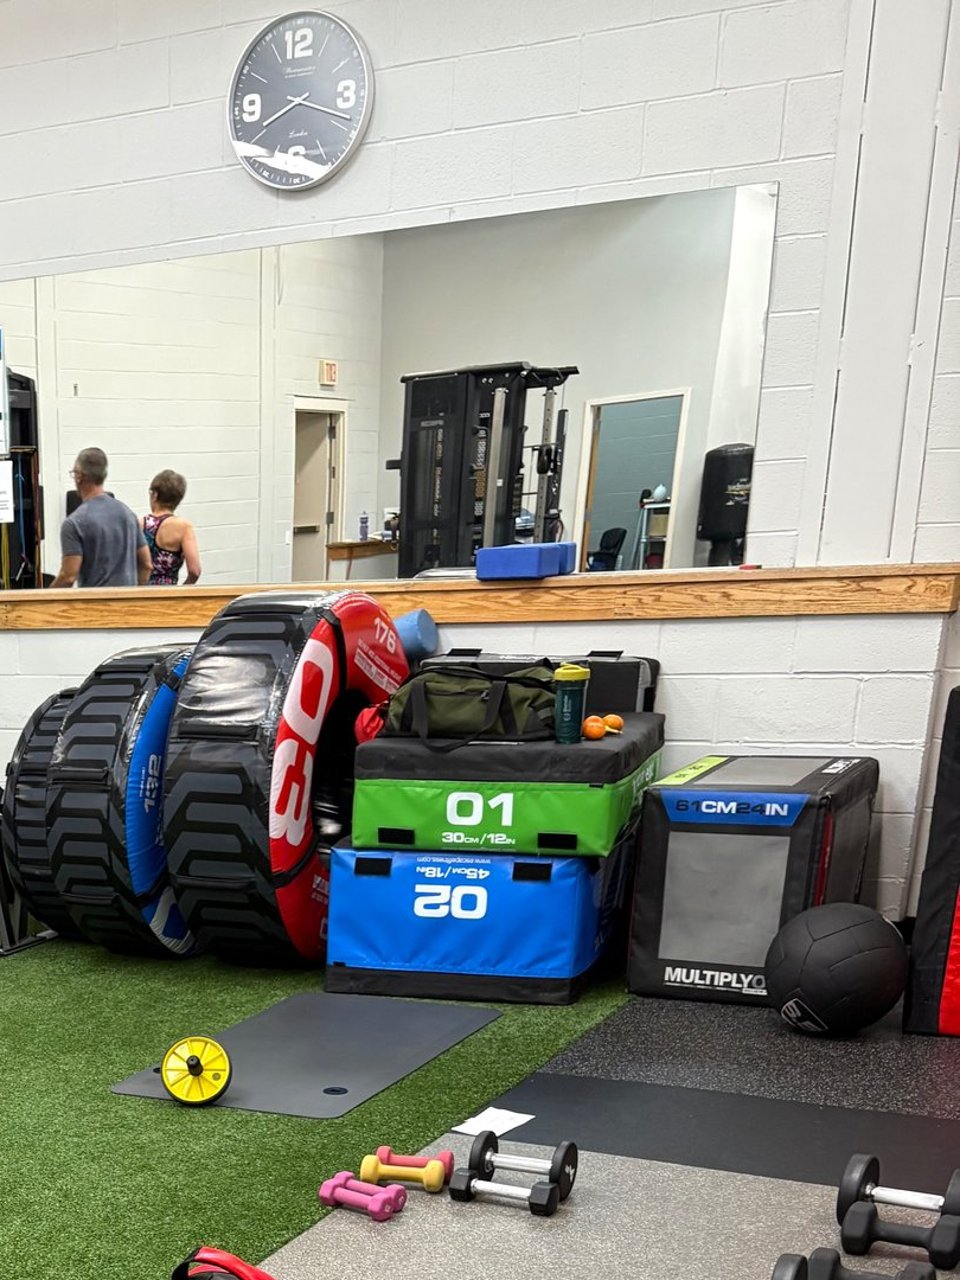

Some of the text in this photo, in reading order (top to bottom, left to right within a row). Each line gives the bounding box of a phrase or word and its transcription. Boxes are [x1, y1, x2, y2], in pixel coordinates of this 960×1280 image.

[284, 27, 313, 60] 12
[242, 93, 261, 123] 9
[336, 79, 356, 109] 3
[446, 791, 514, 826] 01
[413, 884, 488, 920] 02
